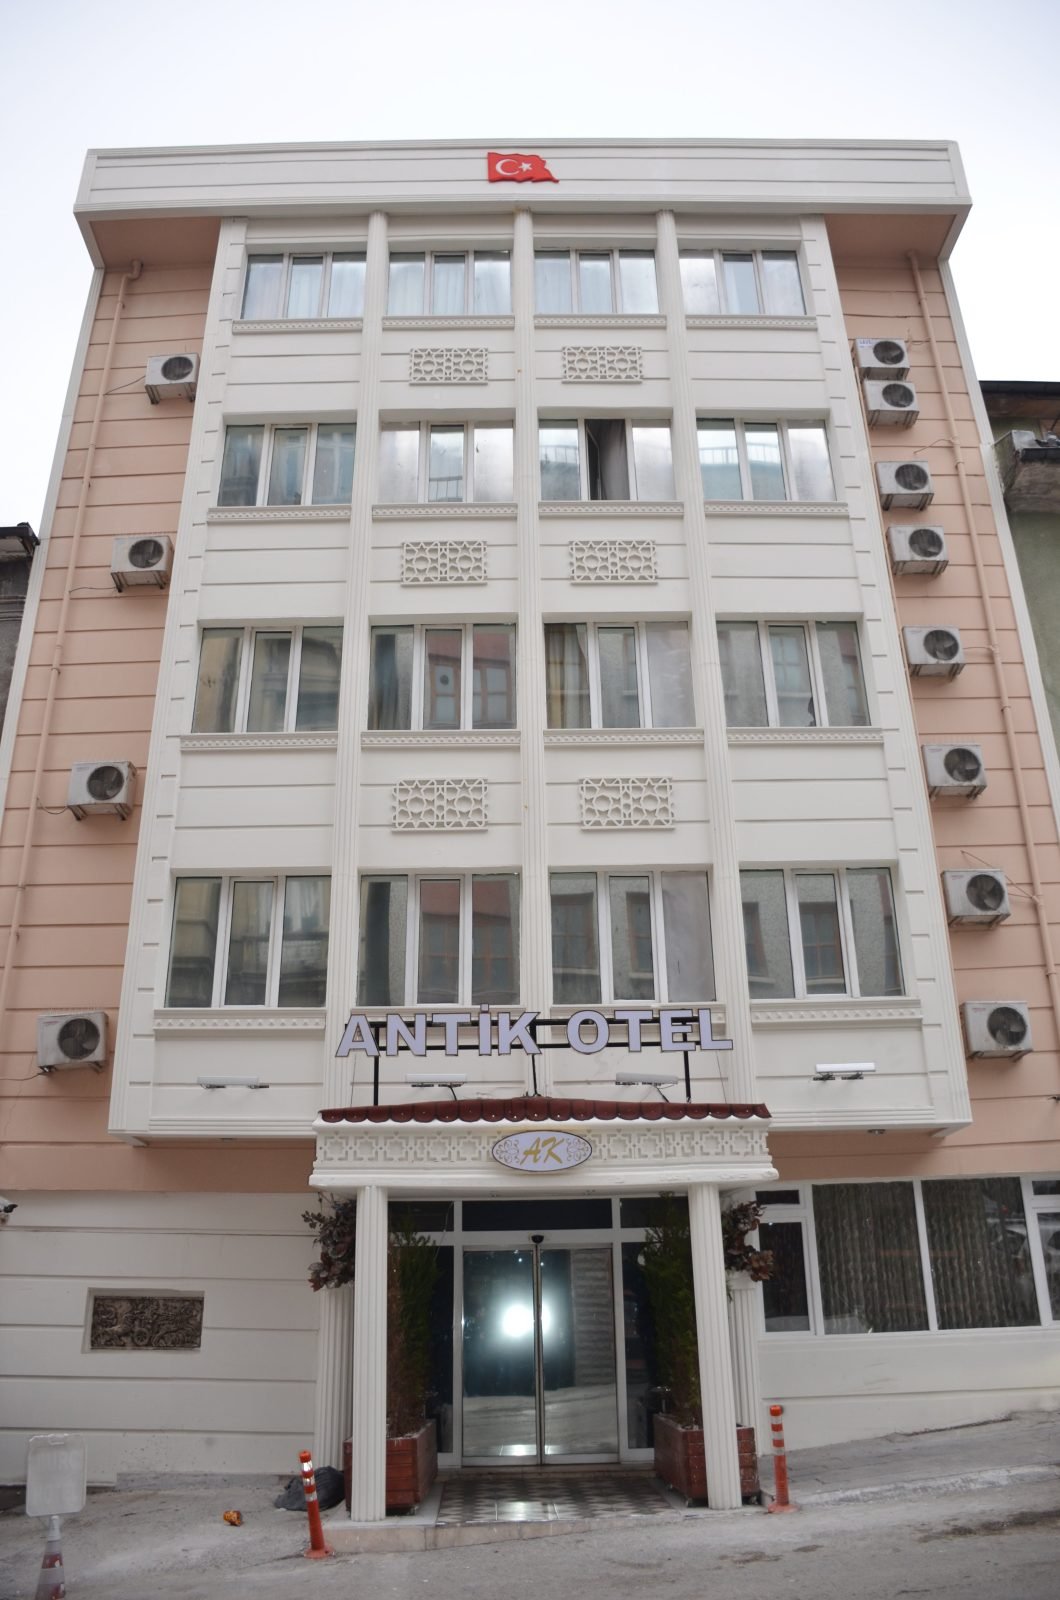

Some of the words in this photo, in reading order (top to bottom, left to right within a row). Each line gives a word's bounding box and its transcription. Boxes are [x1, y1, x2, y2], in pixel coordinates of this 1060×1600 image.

[335, 1003, 542, 1057] ANTİK
[566, 1008, 733, 1054] OTEL
[520, 1136, 566, 1166] AK
